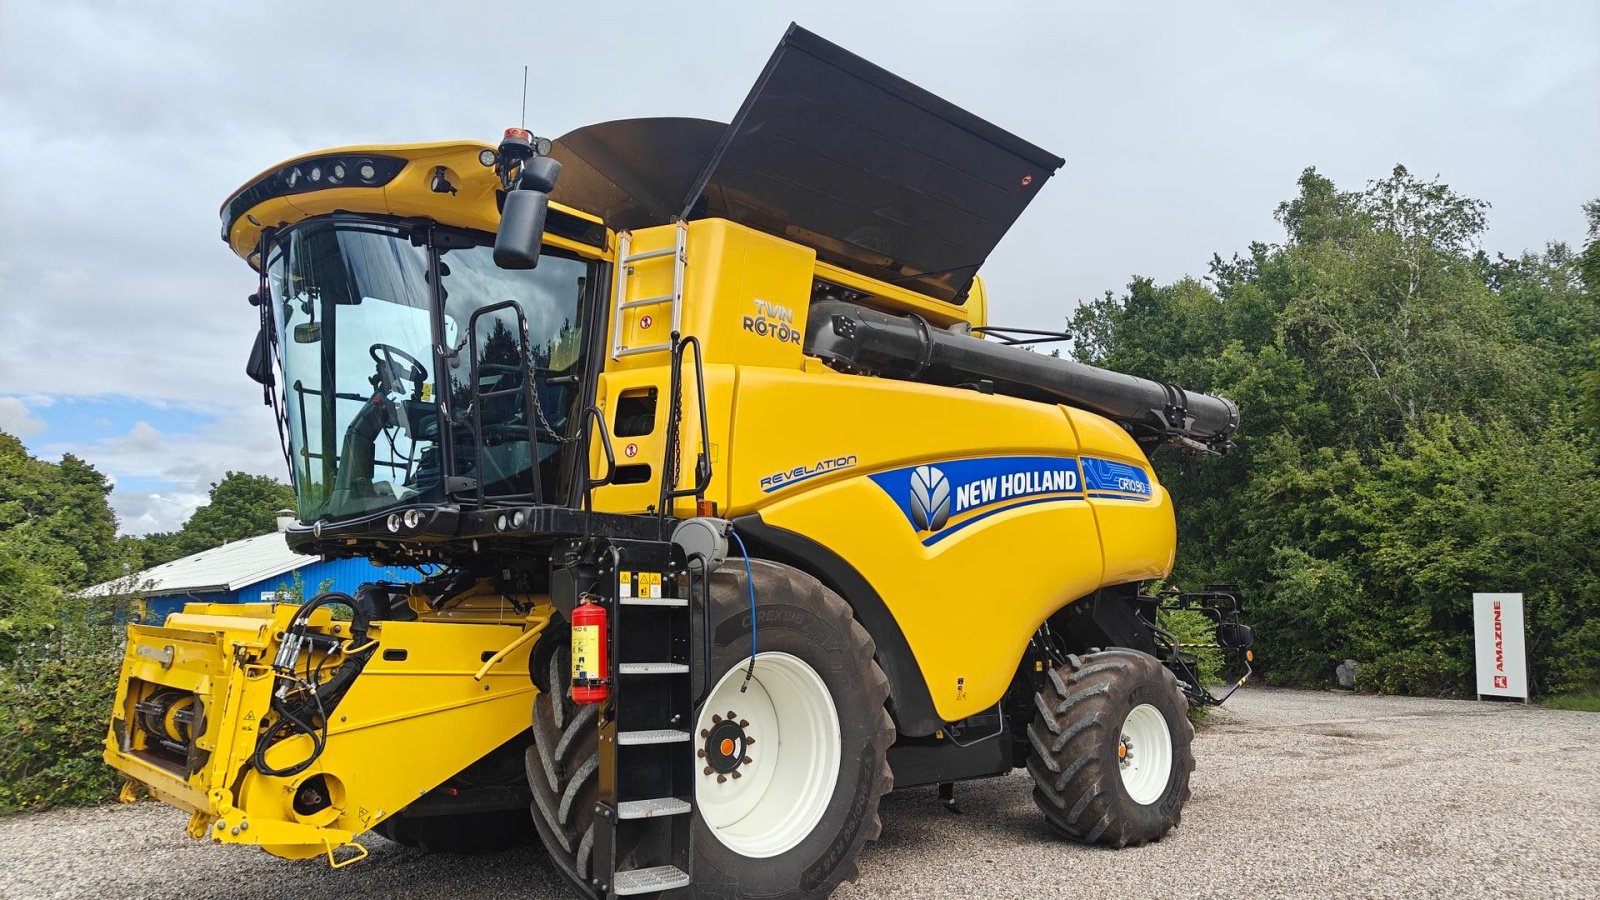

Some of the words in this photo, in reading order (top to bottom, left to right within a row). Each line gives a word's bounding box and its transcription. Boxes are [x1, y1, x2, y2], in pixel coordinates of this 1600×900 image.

[753, 298, 793, 324] TWIN
[743, 316, 801, 346] ROTOR
[760, 455, 857, 488] REVELATION
[956, 476, 998, 512] NEW
[1001, 470, 1077, 498] HOLLAND
[1493, 600, 1504, 672] AMAZONE
